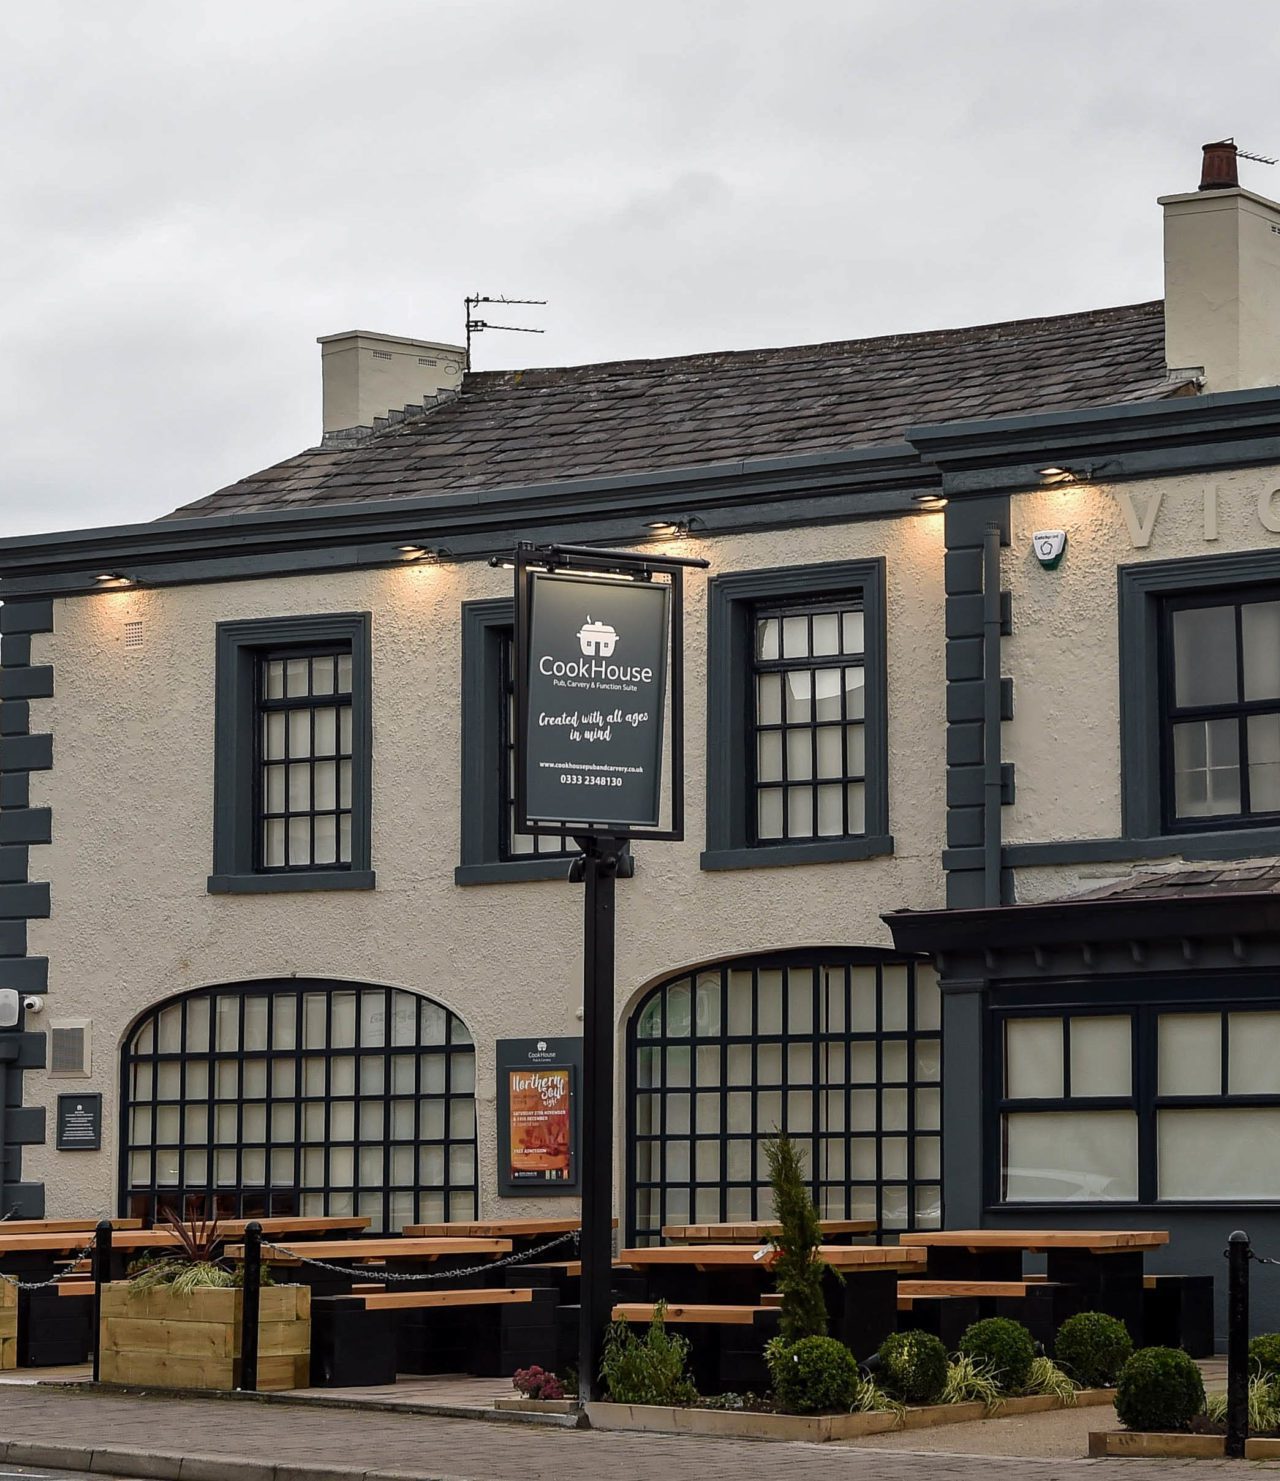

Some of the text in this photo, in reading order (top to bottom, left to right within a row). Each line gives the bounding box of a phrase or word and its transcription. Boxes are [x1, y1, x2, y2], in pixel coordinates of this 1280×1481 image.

[539, 655, 653, 683] CookHouse
[553, 679, 638, 692] Pub, Carvery & Function Suite
[538, 709, 649, 728] Created with all ages
[569, 725, 613, 742] in mind
[539, 761, 644, 774] www.cookhousepubandcarvery.co.uk
[560, 774, 623, 787] 0333 2348130
[512, 1073, 562, 1092] Northern
